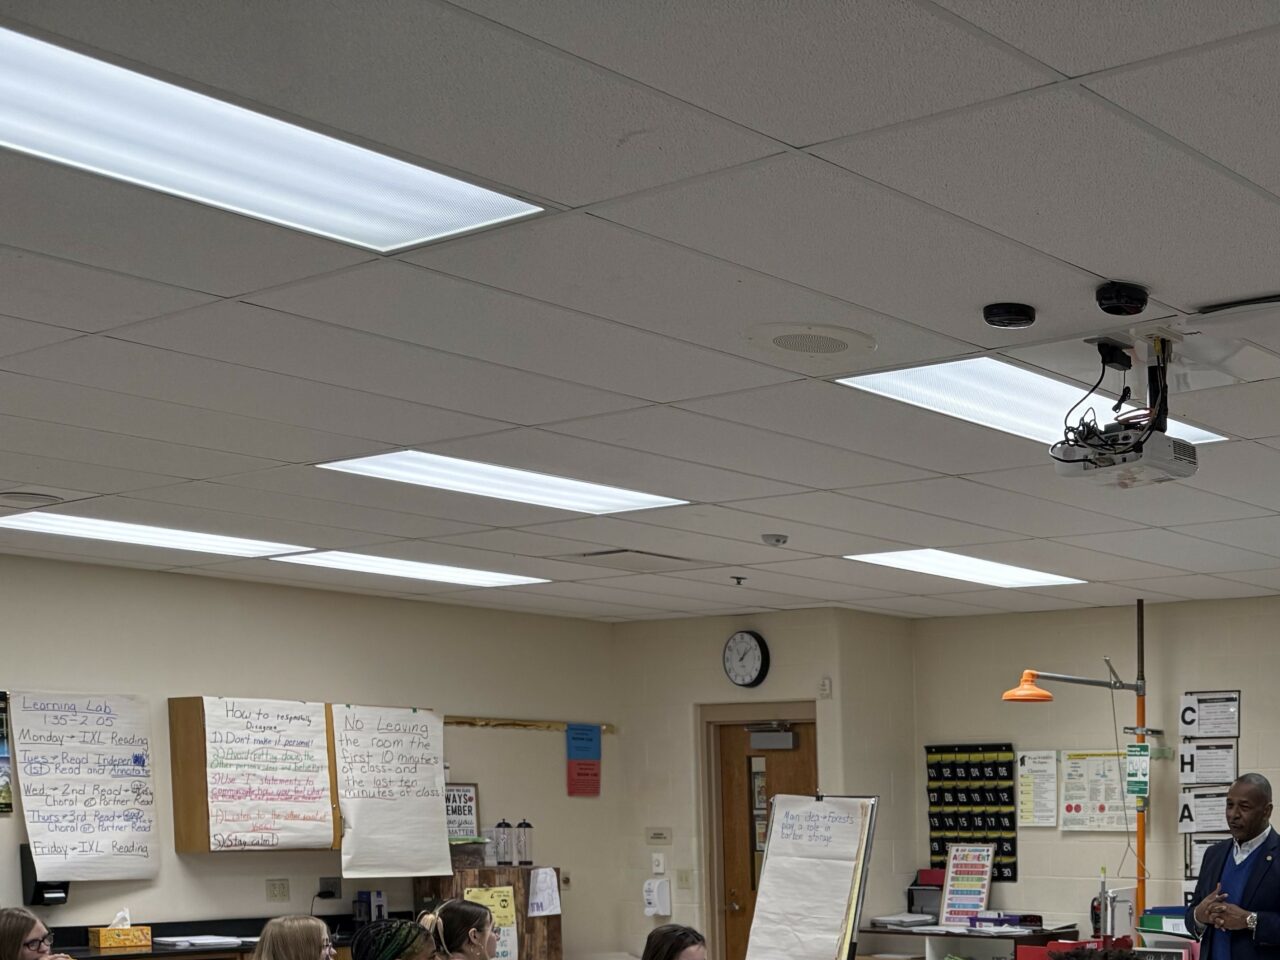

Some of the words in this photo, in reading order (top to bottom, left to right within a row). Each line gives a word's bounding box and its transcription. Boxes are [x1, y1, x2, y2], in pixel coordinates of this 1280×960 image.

[22, 696, 77, 716] Learning
[86, 700, 112, 714] Lab
[226, 701, 251, 719] How
[256, 708, 269, 720] to
[1181, 706, 1196, 725] C
[345, 713, 364, 731] No
[377, 716, 428, 739] Leaving
[19, 729, 64, 746] Monday
[79, 731, 106, 744] IXL
[111, 731, 148, 750] Reading
[226, 732, 250, 744] Don't
[253, 736, 271, 745] make
[339, 733, 360, 747] the
[371, 737, 404, 748] room
[410, 736, 431, 750] the
[19, 750, 48, 763] Tues
[62, 752, 88, 764] Read
[341, 750, 372, 763] first
[382, 750, 394, 763] 10
[398, 754, 439, 765] minutes
[55, 764, 80, 775] Read
[88, 765, 105, 775] and
[342, 764, 353, 774] of
[1180, 754, 1194, 773] H
[942, 769, 951, 777] 02
[984, 768, 993, 776] 05
[998, 768, 1008, 776] 06
[260, 776, 300, 786] statements
[306, 776, 314, 785] to
[345, 776, 365, 786] the
[373, 776, 394, 788] last
[398, 777, 418, 788] ten
[62, 784, 85, 795] 2nd
[93, 784, 122, 796] Read
[345, 788, 394, 799] minutes
[400, 788, 410, 797] of
[416, 787, 444, 797] class!
[45, 796, 77, 806] Choral
[100, 796, 131, 806] Partner
[134, 794, 153, 806] Read
[445, 793, 468, 804] WAYS
[930, 793, 937, 801] 07
[986, 793, 994, 801] 11
[1000, 793, 1008, 801] 12
[27, 810, 61, 823] Thurs
[70, 810, 86, 822] 3rd
[94, 811, 114, 822] Read
[257, 809, 265, 820] to
[446, 805, 473, 816] EMBER
[1179, 804, 1194, 822] A
[827, 812, 854, 824] Forests
[931, 818, 939, 826] 13
[945, 818, 953, 826] 14
[959, 818, 967, 826] 15
[974, 818, 982, 826] 16
[987, 818, 995, 826] 17
[48, 822, 78, 833] Choral
[98, 822, 129, 832] Partner
[132, 822, 152, 832] Read
[807, 823, 819, 831] role
[227, 834, 247, 849] Stay
[33, 841, 68, 860] Friday
[78, 842, 104, 854] IXL
[112, 840, 149, 858] Reading
[953, 853, 990, 862] AGREEMENT
[1002, 868, 1011, 876] 30
